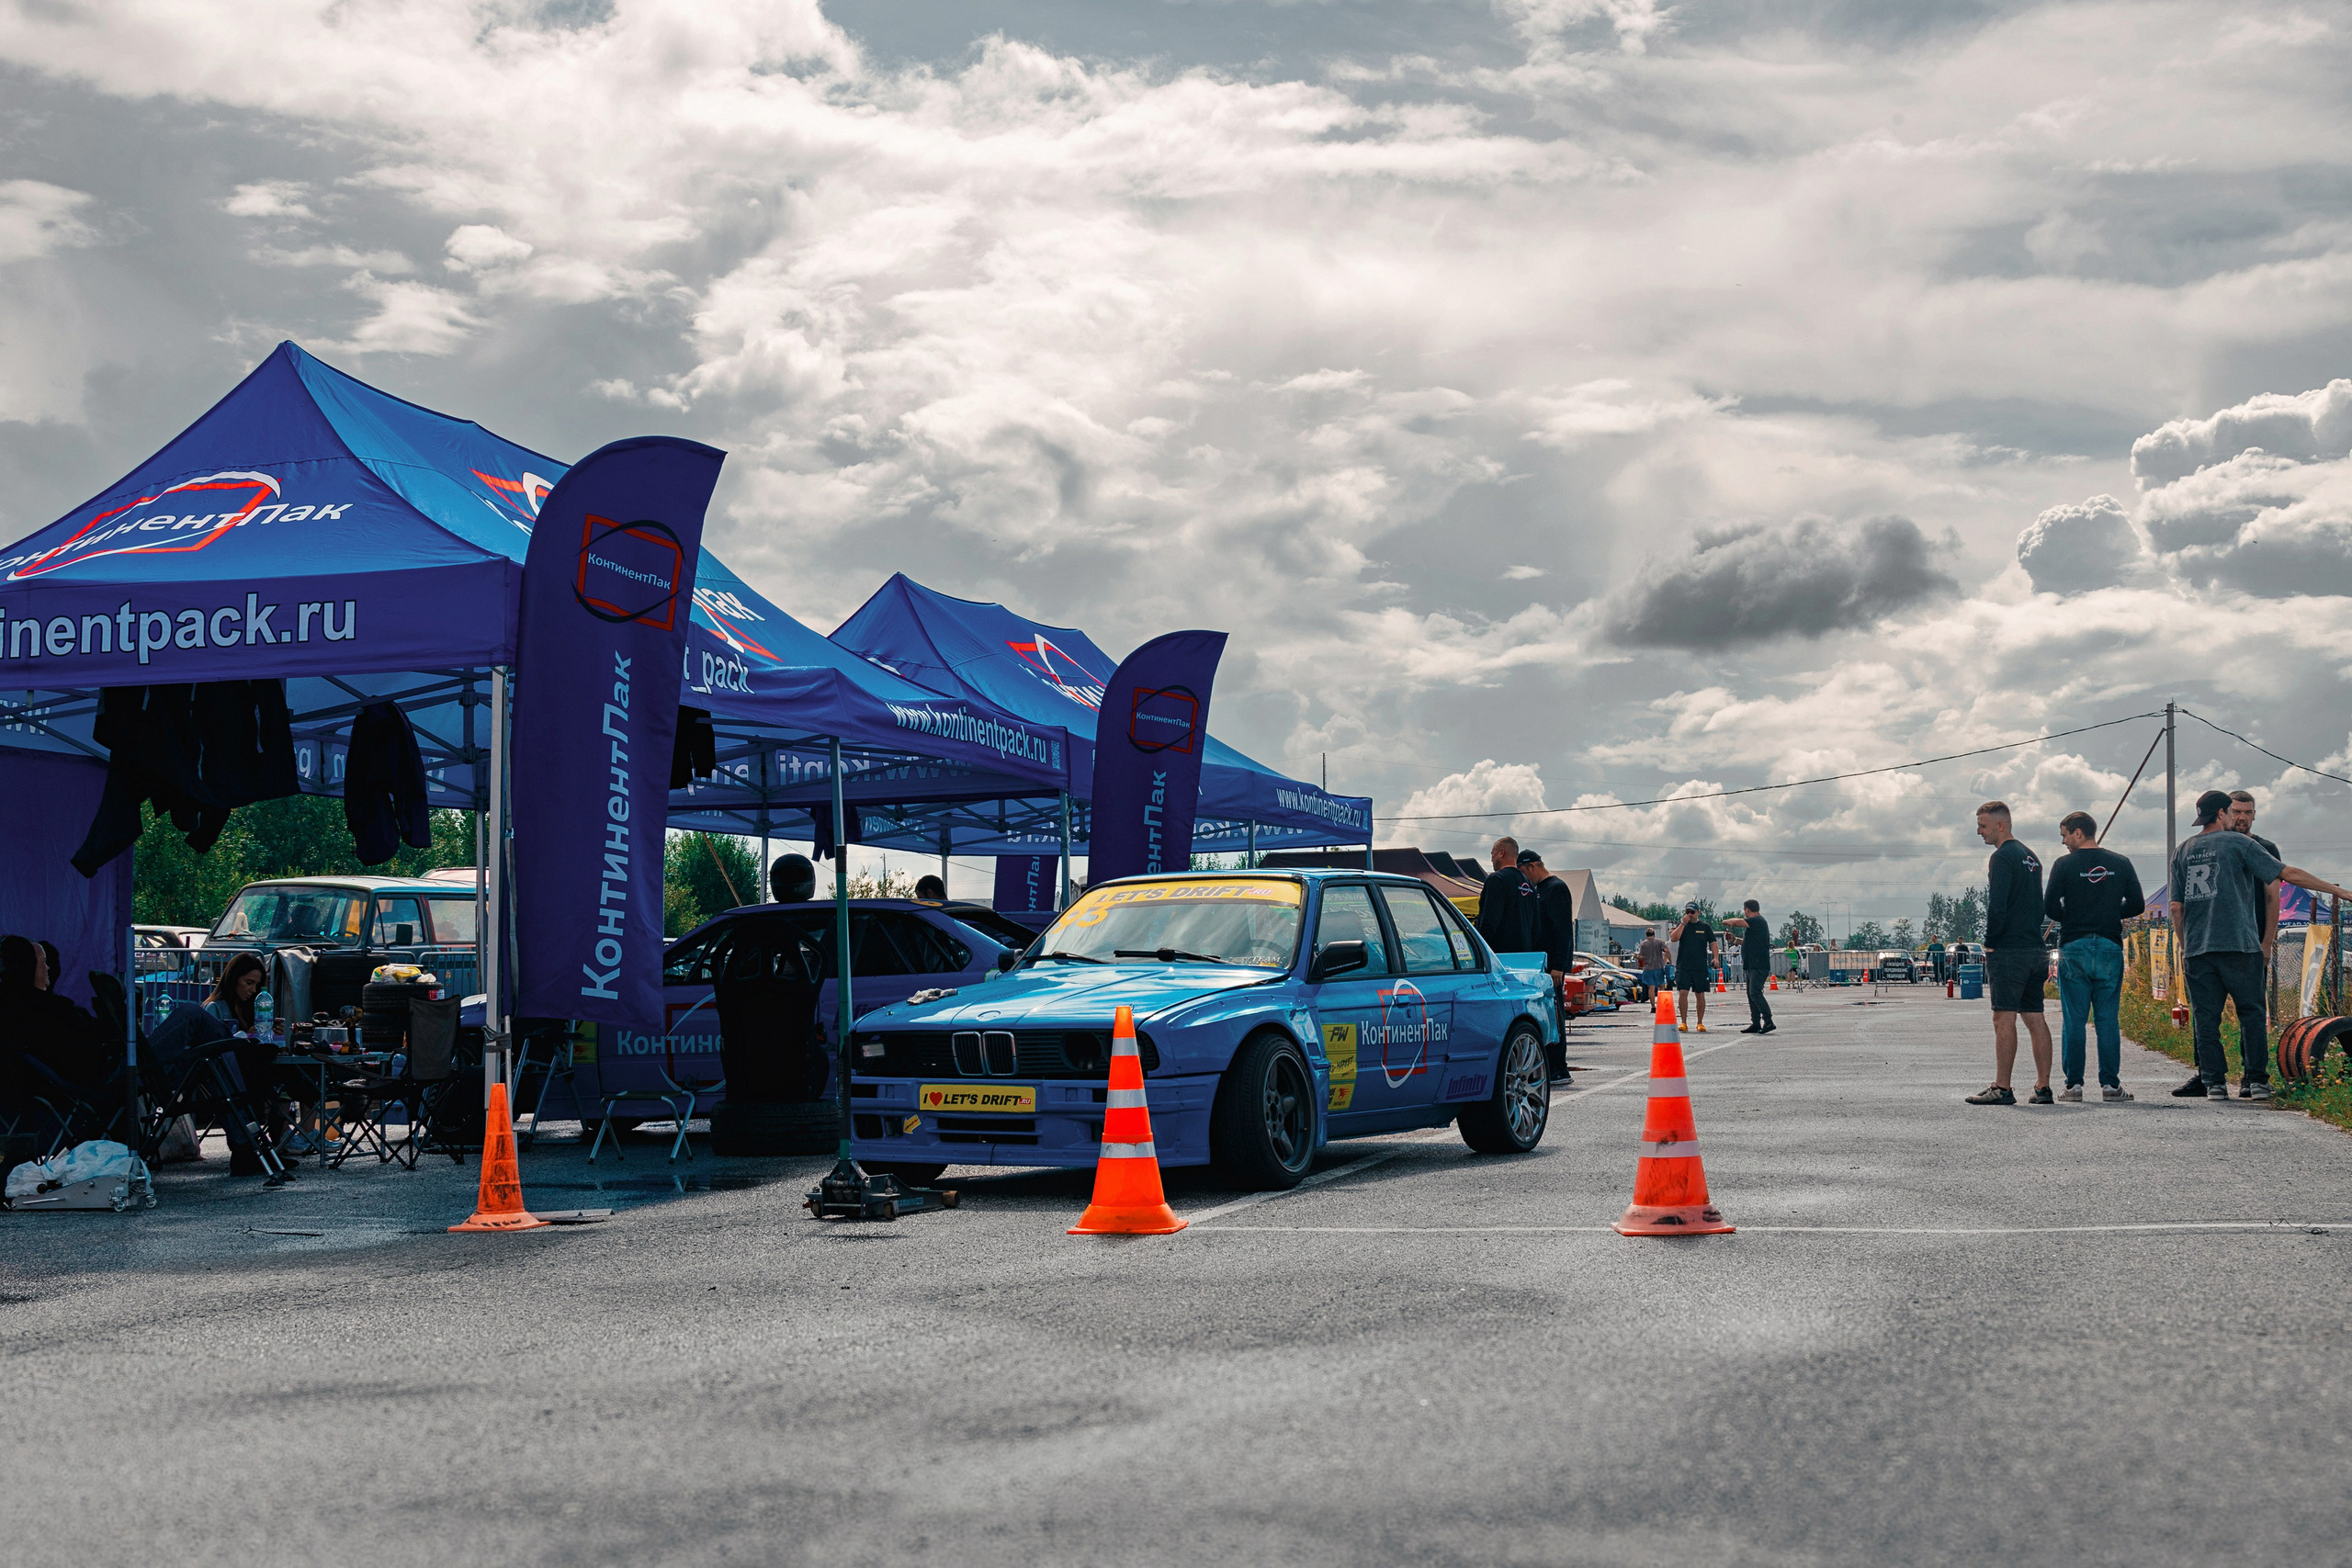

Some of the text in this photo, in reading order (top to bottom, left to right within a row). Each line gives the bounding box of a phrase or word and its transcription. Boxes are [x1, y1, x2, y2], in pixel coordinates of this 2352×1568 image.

[587, 552, 672, 591] КонтинентПак
[885, 702, 1047, 764] www.kontinentpack.ru
[1136, 711, 1191, 729] КонтинентПак
[1276, 786, 1362, 828] www.kontinentpack.ru
[581, 649, 632, 1000] КонтинентПак
[1453, 934, 1465, 951] 93
[1361, 1018, 1449, 1045] КонтинентПак
[1447, 1074, 1488, 1096] Infinity
[922, 1093, 929, 1104] I
[943, 1093, 978, 1105] LET'S
